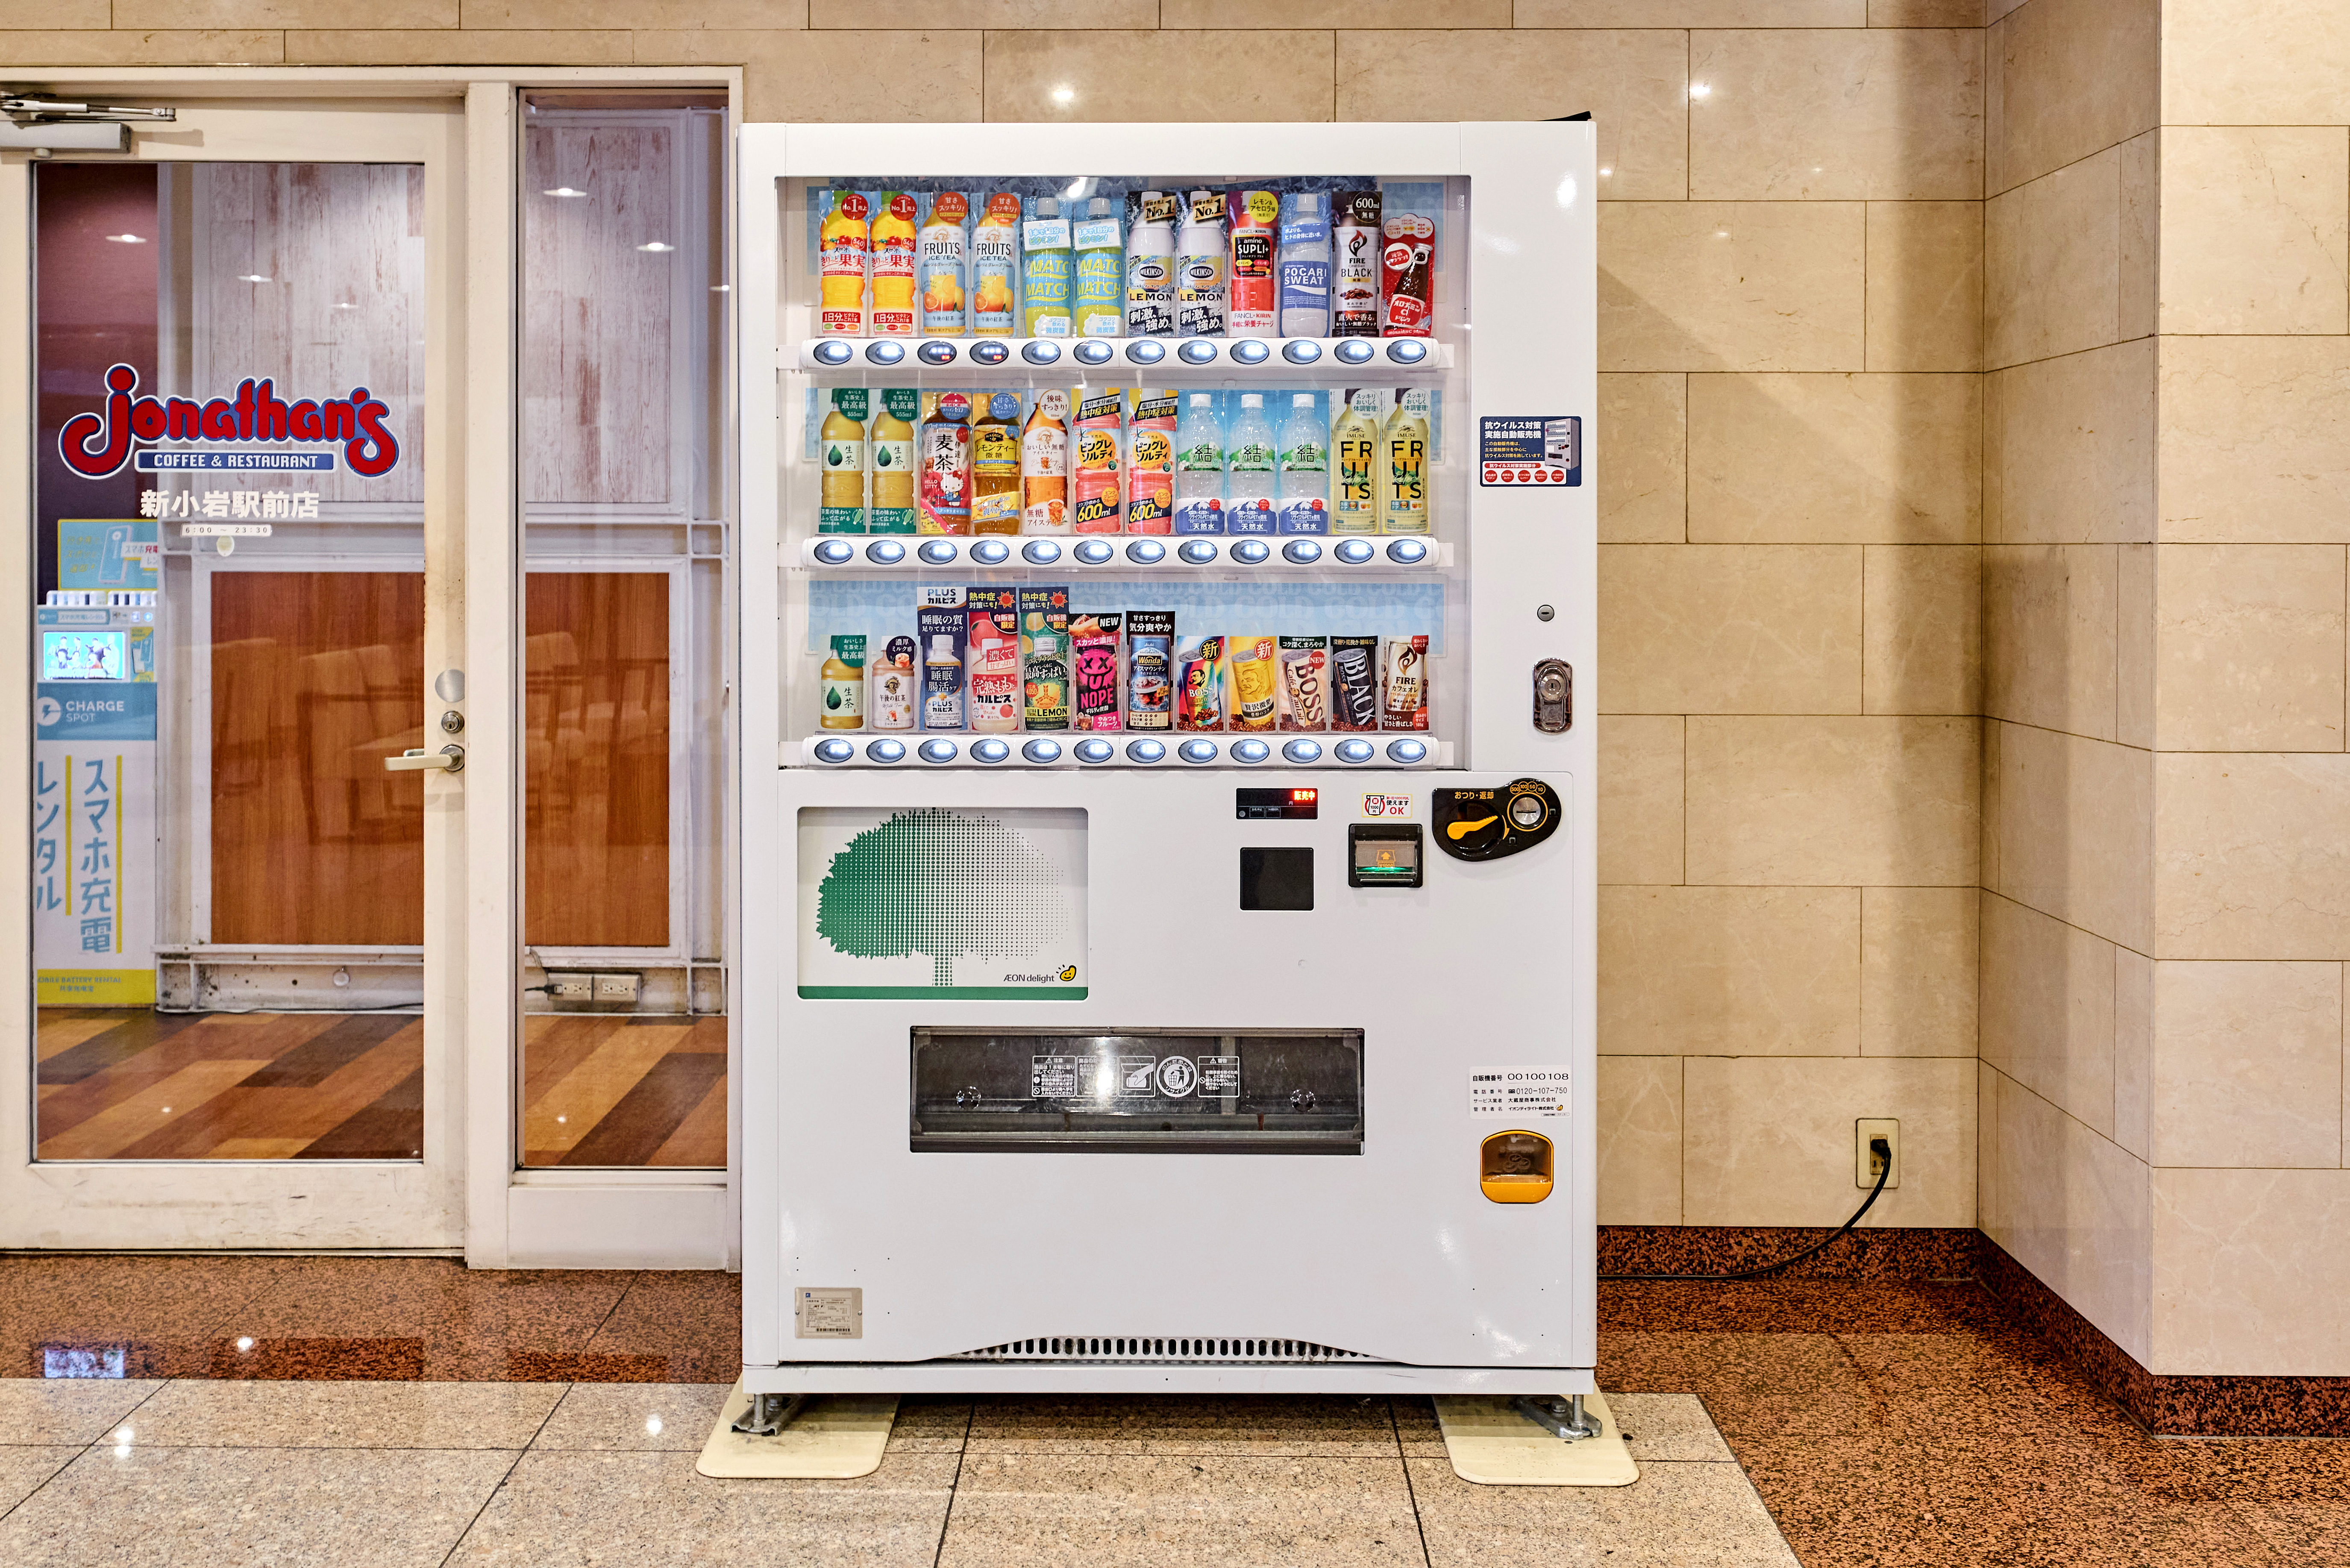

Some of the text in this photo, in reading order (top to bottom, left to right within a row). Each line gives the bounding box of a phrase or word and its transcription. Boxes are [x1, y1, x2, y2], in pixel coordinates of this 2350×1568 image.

[1356, 198, 1380, 209] 600ml
[925, 243, 960, 255] FRUITS
[977, 244, 1010, 255] FRUITS
[821, 254, 865, 268] きりっと果実
[1140, 268, 1163, 276] WILKINSON
[1190, 268, 1213, 276] WILKINSON
[1285, 268, 1326, 277] POCARI
[1341, 268, 1372, 277] BLACK
[1284, 276, 1324, 285] SWEAT
[1026, 282, 1069, 297] MATCH
[1077, 281, 1121, 297] MATCH
[1393, 300, 1420, 312] オロナミン
[841, 401, 867, 410] 最高級
[890, 402, 915, 410] 最高級
[1080, 403, 1117, 419] 熱中症対策
[1485, 421, 1541, 429] 抗ウイルス対策
[1485, 431, 1541, 439] 実施自動販売機
[935, 434, 954, 471] 麦茶
[977, 444, 1014, 452] レモンティー
[1080, 440, 1112, 453] ピングレ
[845, 445, 855, 465] 生茶
[1082, 450, 1113, 462] ソルティ
[1195, 444, 1212, 462] 結
[1244, 444, 1261, 462] 結
[1297, 444, 1315, 462] 結
[154, 455, 317, 467] COFFEE & RESTAURANT
[140, 489, 319, 518] 新小岩駅前店
[1027, 509, 1043, 517] 無糖
[969, 592, 996, 601] 熱中症
[1022, 592, 1048, 602] 熱中症
[922, 615, 964, 625] 睡眠の質
[1100, 617, 1119, 628] NEW
[1129, 623, 1172, 632] 気分爽やか
[1076, 635, 1116, 647] スカッと濃厚!
[989, 649, 1014, 661] 濃くて
[1203, 643, 1219, 658] 新
[1256, 643, 1272, 658] 新
[931, 670, 953, 681] 睡眠
[928, 681, 957, 692] 腸活ケア
[1189, 684, 1213, 697] BOSS
[1344, 656, 1375, 725] BLACK
[844, 687, 854, 708] 生茶
[977, 694, 1011, 703] カルピス
[1081, 688, 1113, 709] NOPE
[1295, 664, 1323, 722] BOSS
[66, 701, 124, 712] CHARGE
[1037, 708, 1067, 716] LEMON
[66, 714, 95, 722] SPOT
[1294, 791, 1315, 800] 販売中
[37, 761, 62, 911] レンタル
[81, 759, 111, 953] スマホ充電
[1027, 975, 1055, 983] delight
[1163, 1059, 1193, 1072] のんだあとは
